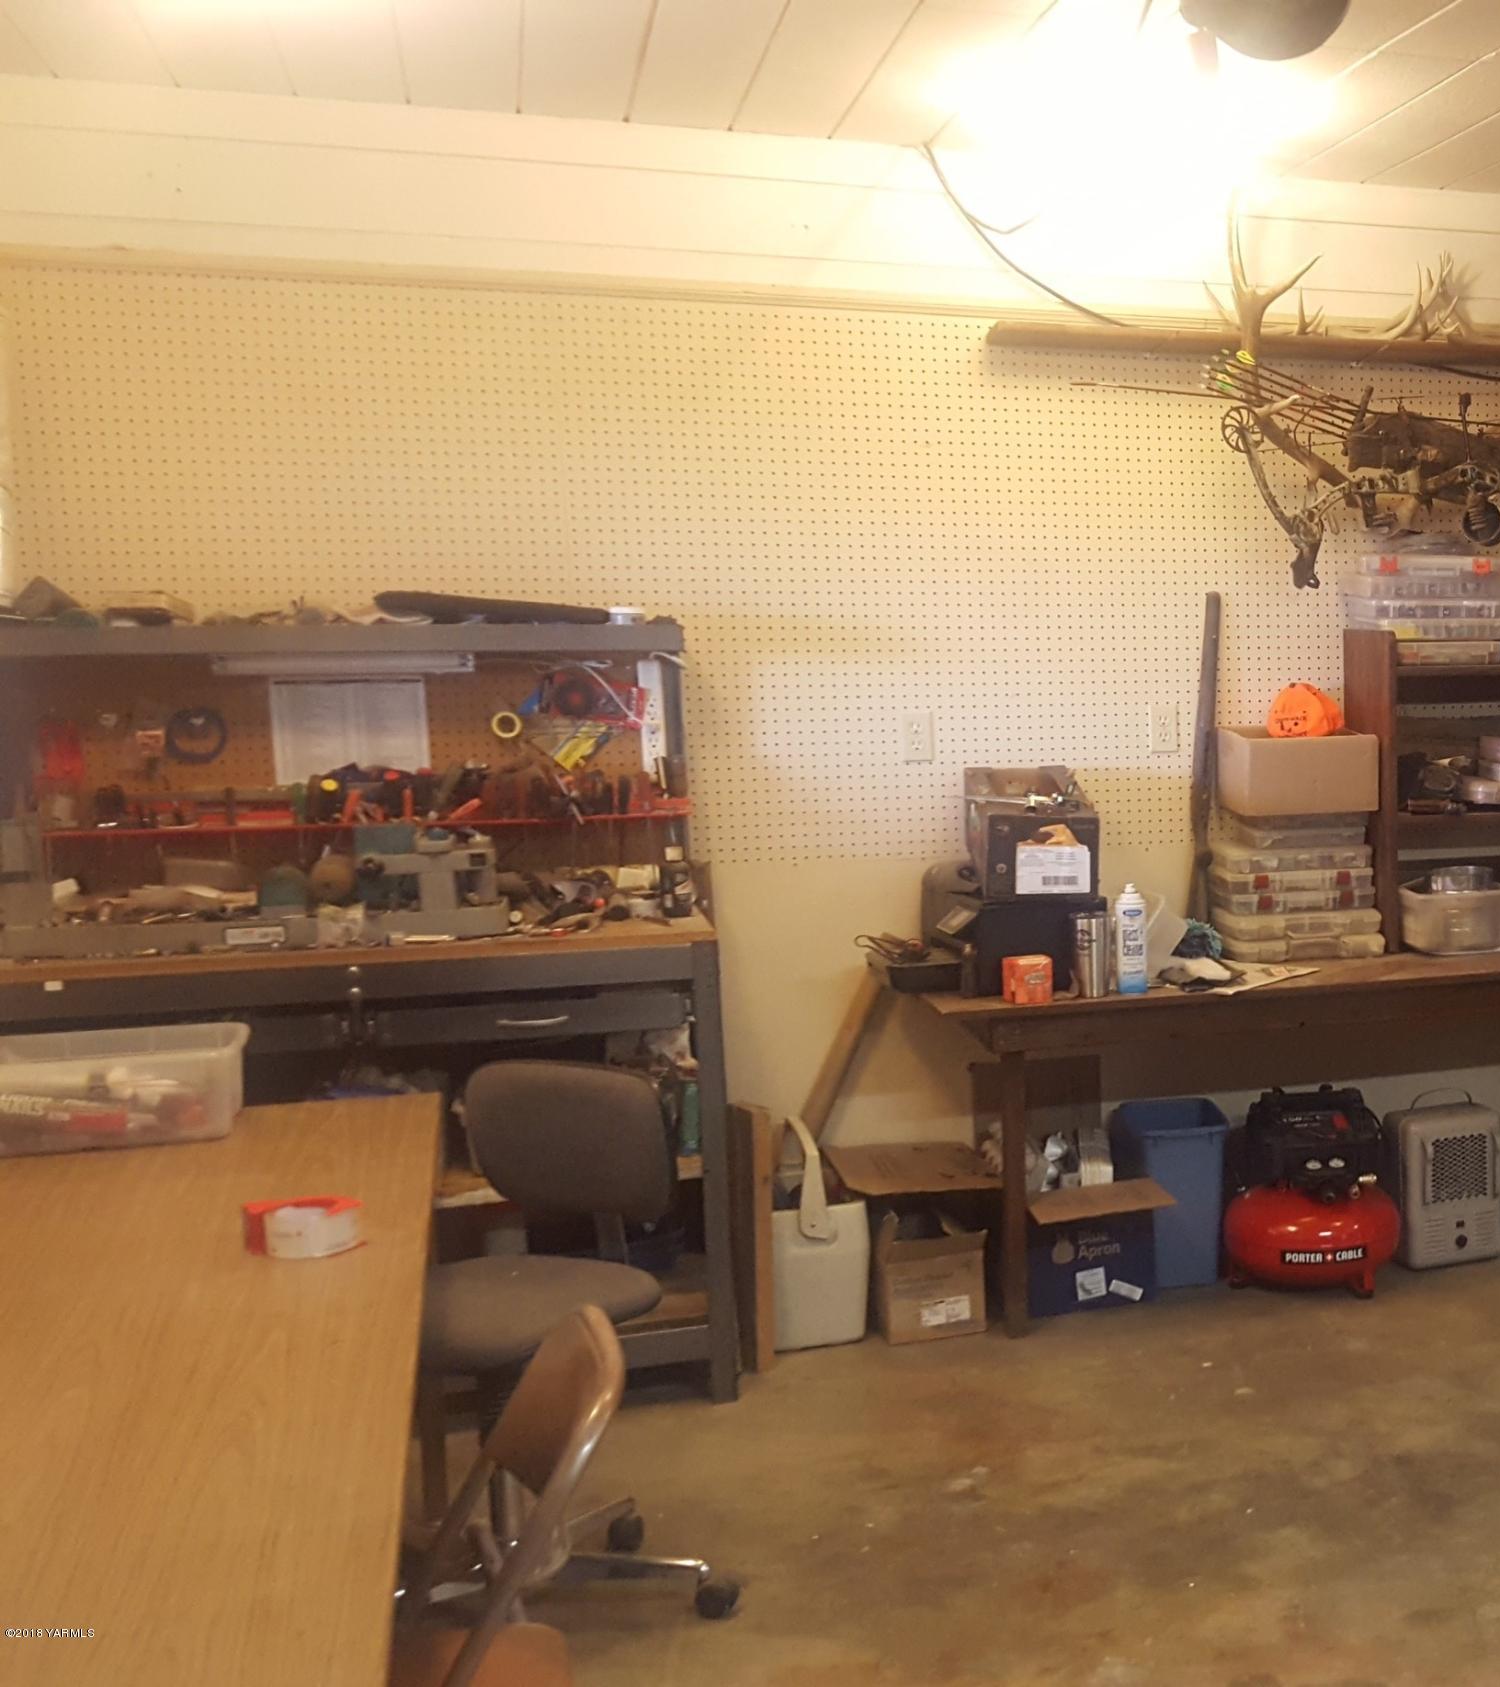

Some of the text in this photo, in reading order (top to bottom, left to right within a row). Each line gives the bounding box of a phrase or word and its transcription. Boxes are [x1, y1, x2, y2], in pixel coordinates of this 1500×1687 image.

[1078, 1243, 1121, 1261] Apron
[1285, 1248, 1363, 1264] PORTER CABLE
